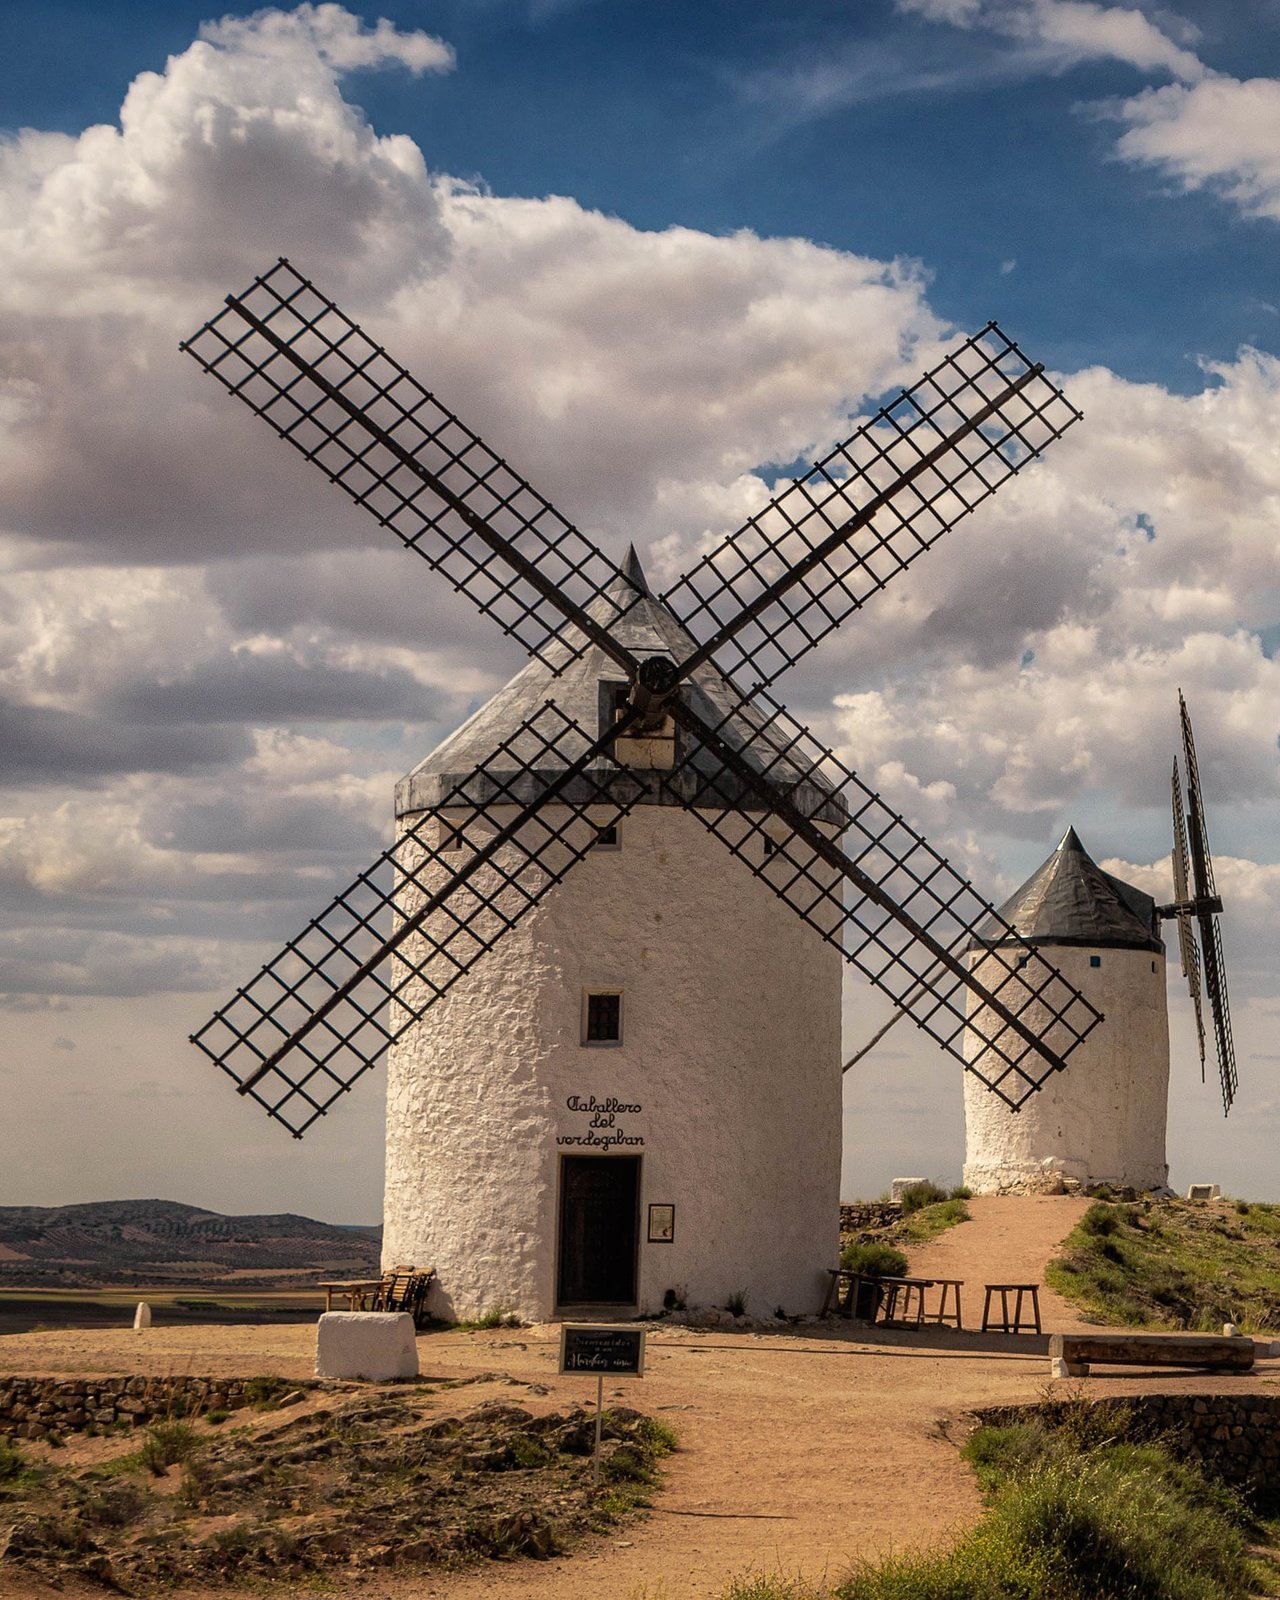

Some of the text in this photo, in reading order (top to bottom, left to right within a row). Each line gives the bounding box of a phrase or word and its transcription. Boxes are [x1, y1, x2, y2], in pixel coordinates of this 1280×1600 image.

[567, 1095, 642, 1113] Caballero
[589, 1112, 615, 1128] del
[556, 1129, 645, 1151] verdegaban
